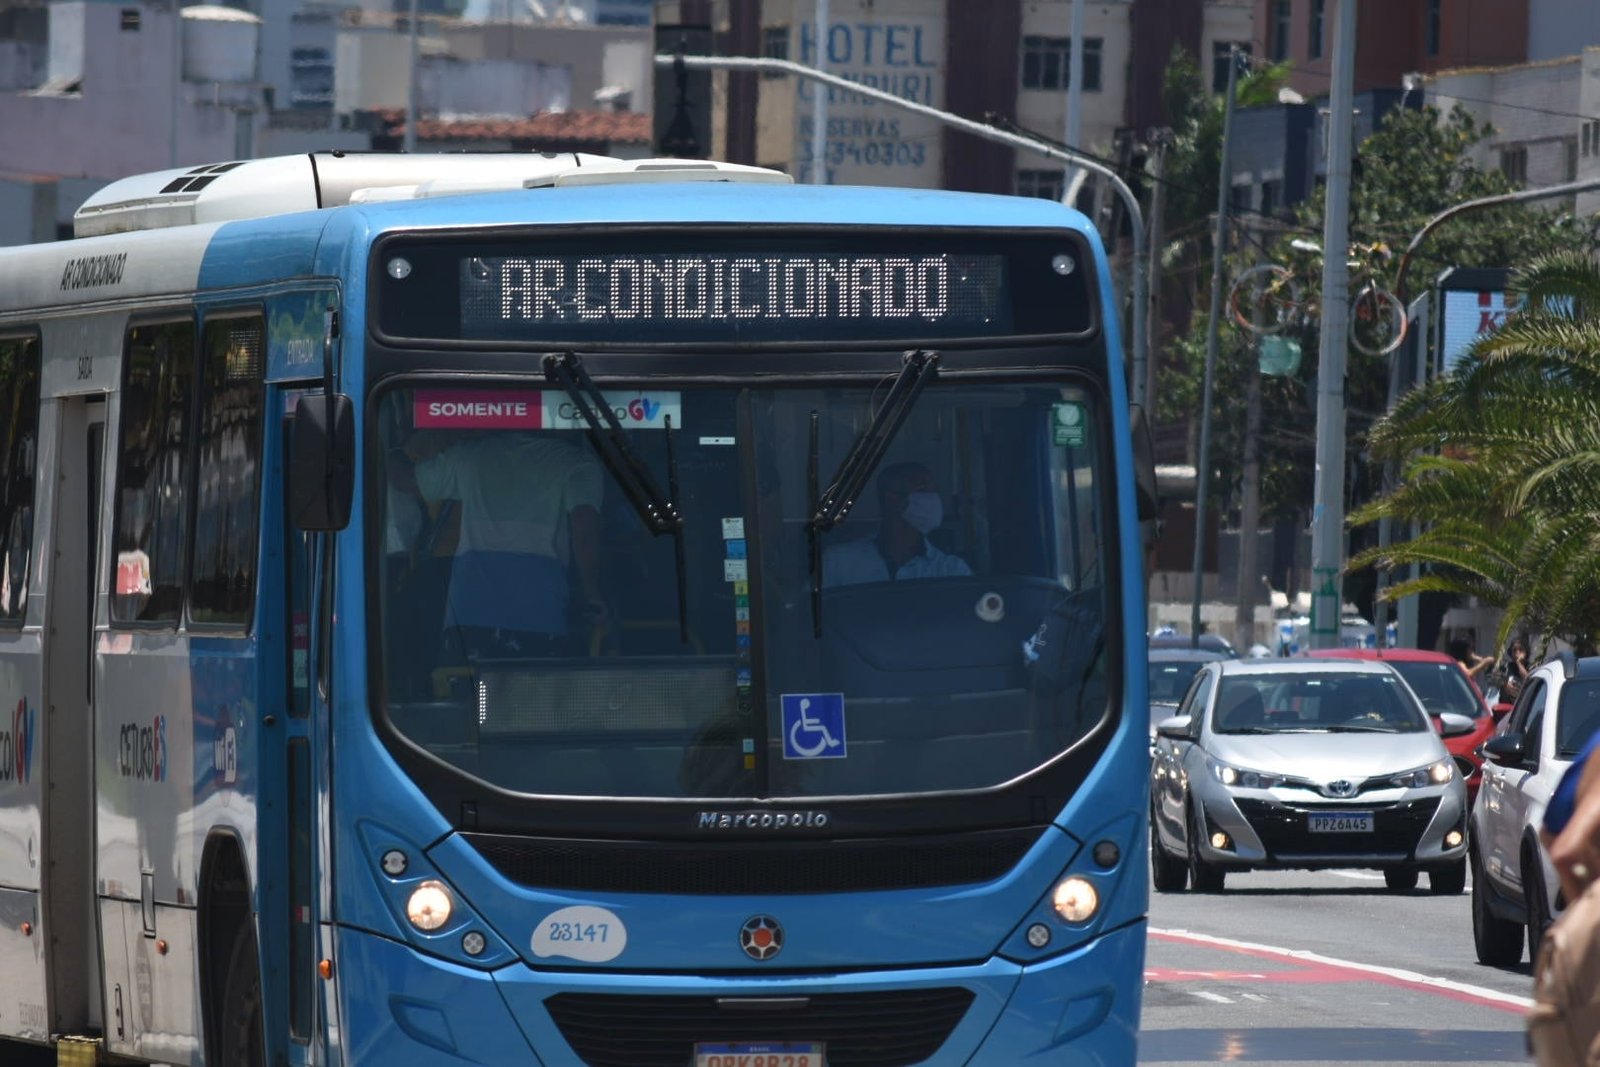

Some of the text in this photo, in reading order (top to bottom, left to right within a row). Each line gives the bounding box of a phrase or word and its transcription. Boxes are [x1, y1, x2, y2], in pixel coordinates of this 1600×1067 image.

[801, 23, 936, 67] HOTEL
[800, 117, 899, 138] RSERVAS
[799, 140, 926, 167] 3340303
[501, 257, 948, 318] AR CONDICIONADO
[428, 402, 528, 417] SOMENTE
[698, 811, 828, 829] Marcopolo
[1314, 818, 1368, 831] PPZ6A45
[549, 922, 609, 943] 23147
